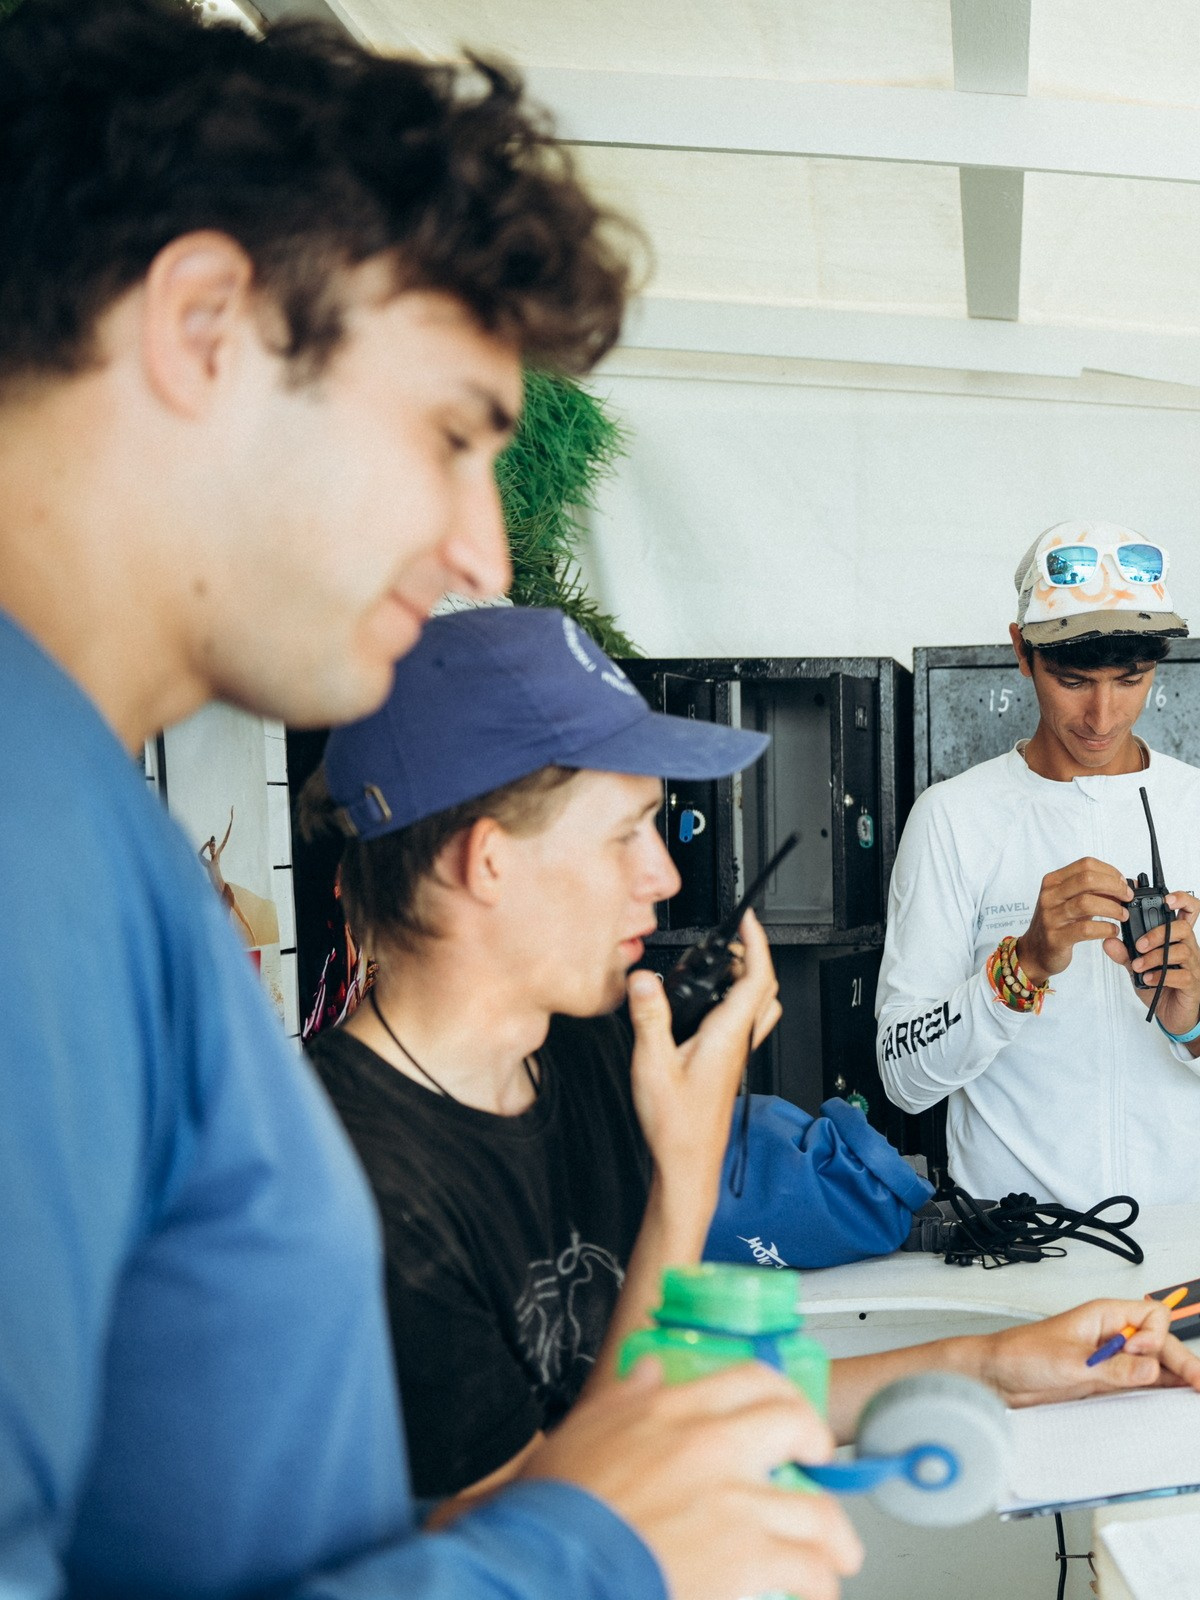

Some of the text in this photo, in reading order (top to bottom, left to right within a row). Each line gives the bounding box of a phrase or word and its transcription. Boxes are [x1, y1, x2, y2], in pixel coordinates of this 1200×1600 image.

[989, 688, 1013, 713] 15
[1145, 685, 1167, 709] 16
[985, 902, 1030, 916] TRAVEL
[851, 977, 862, 1008] 21
[882, 1000, 962, 1062] ARREL
